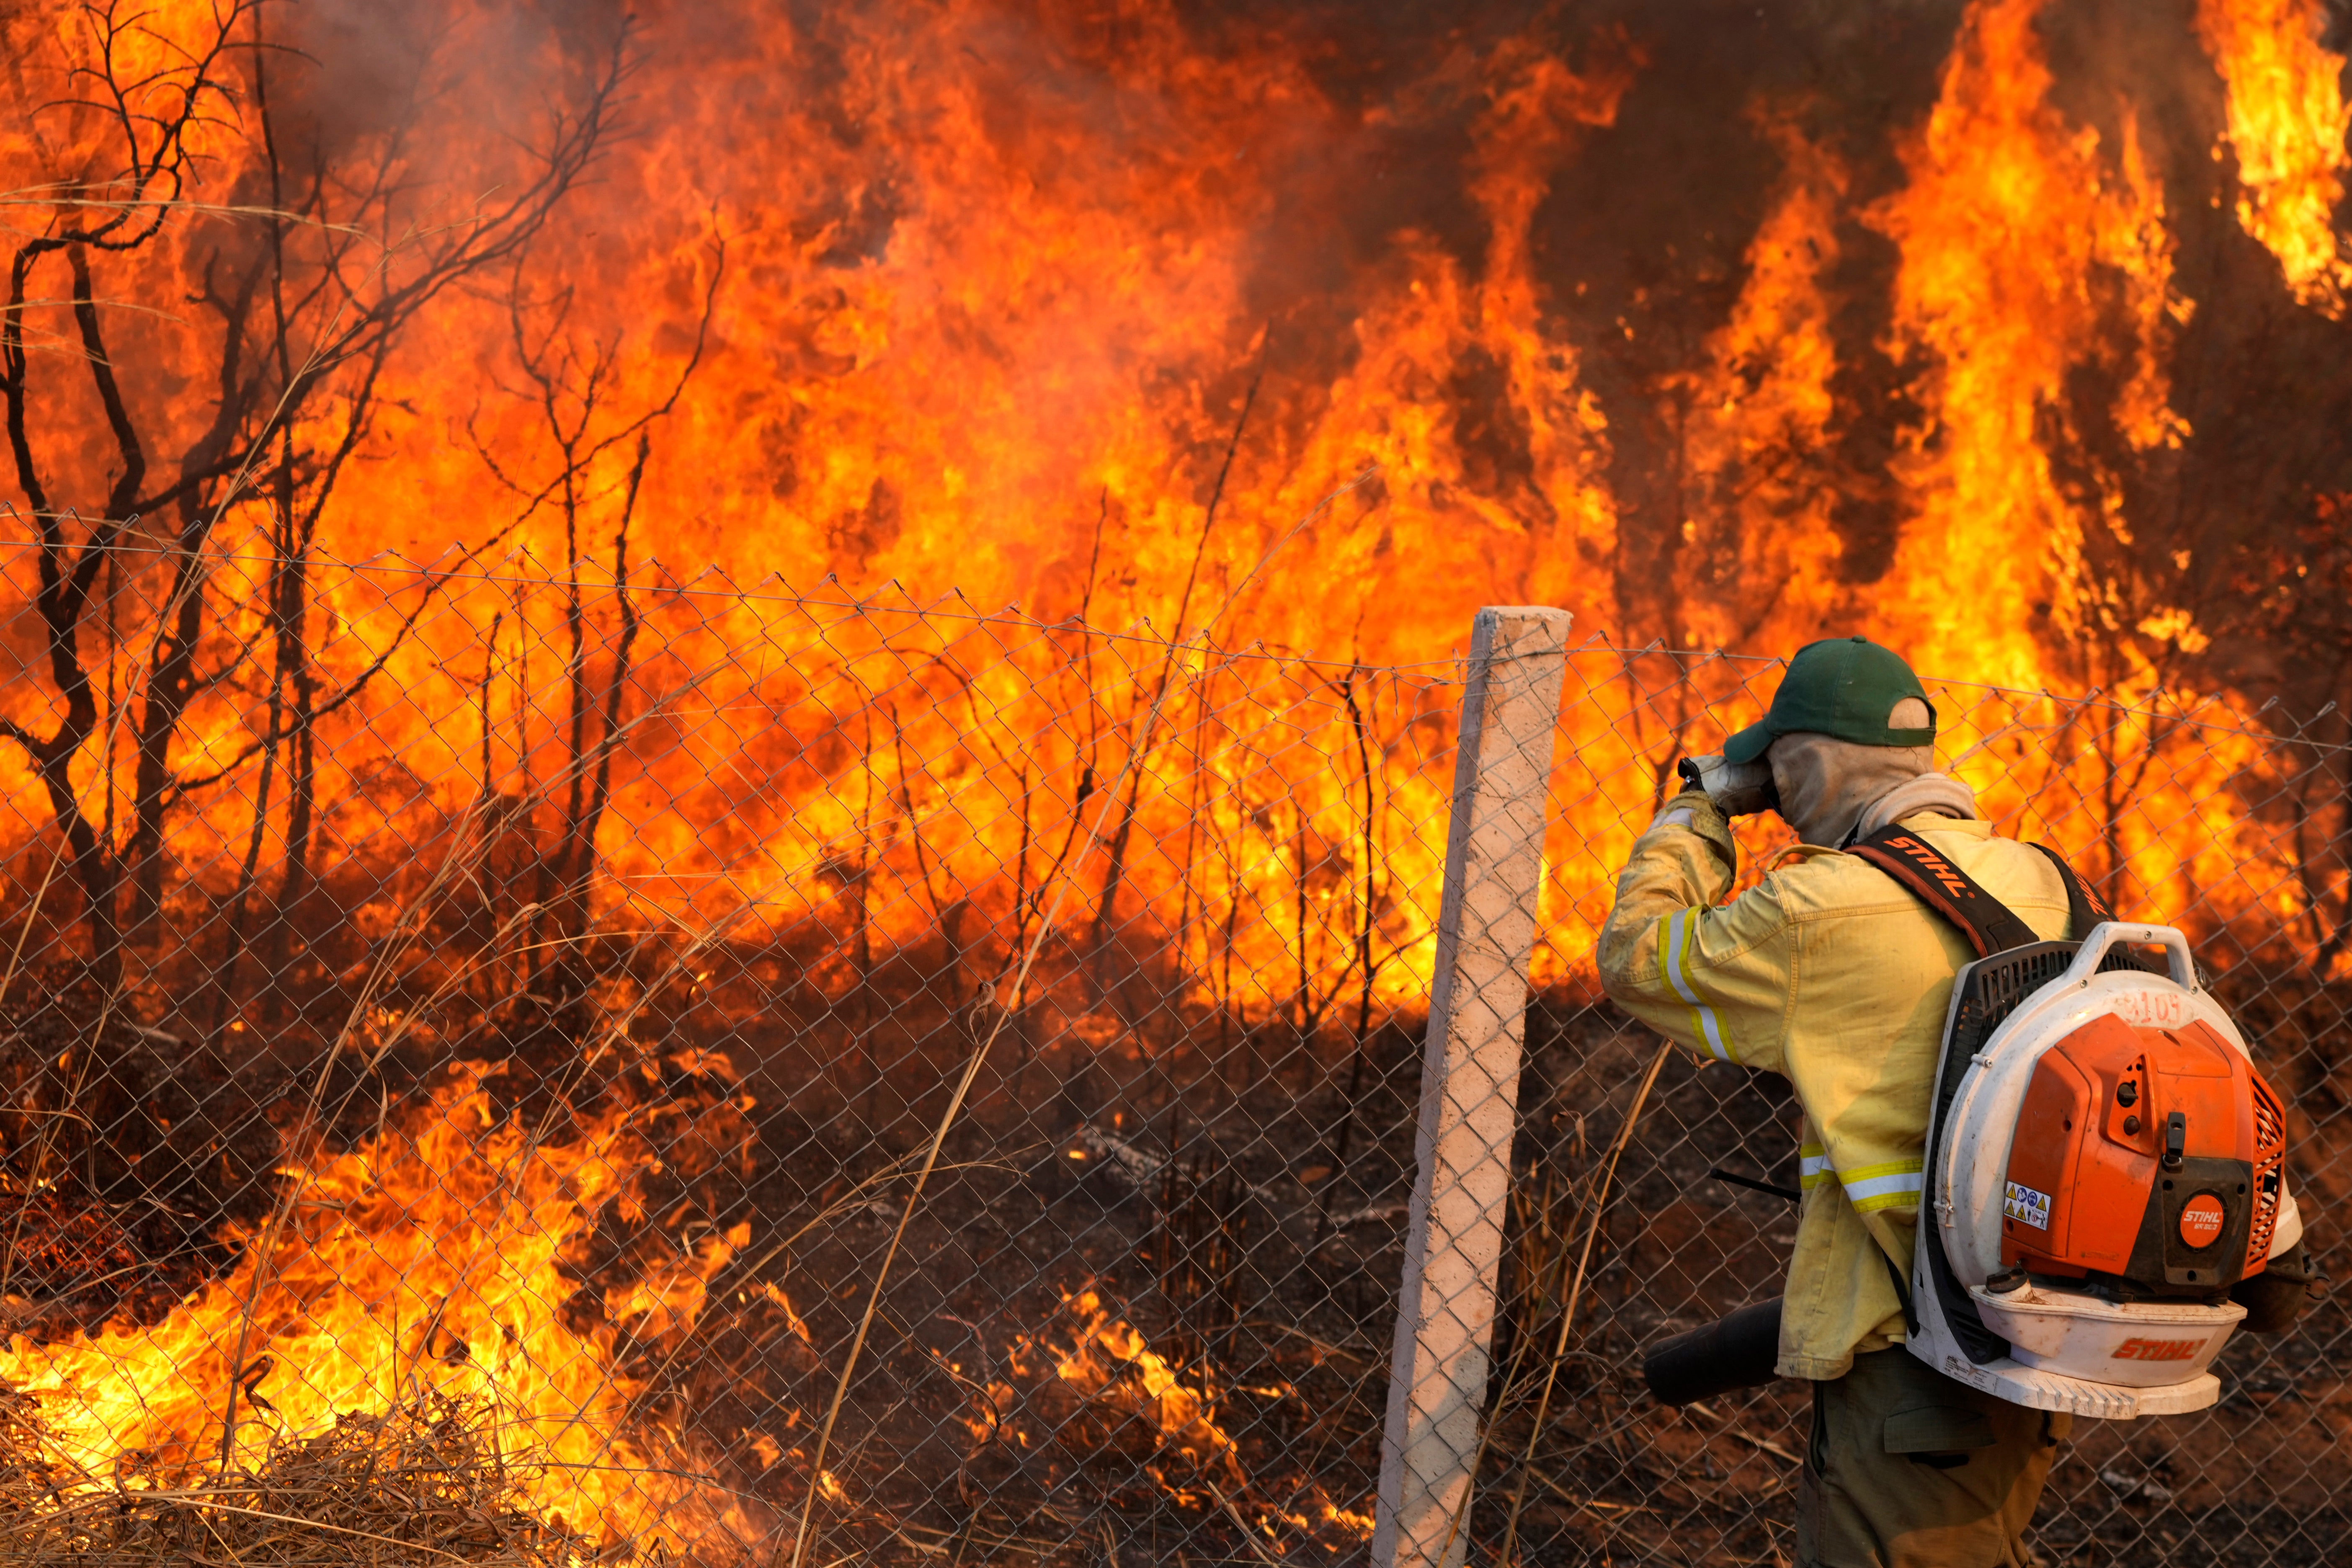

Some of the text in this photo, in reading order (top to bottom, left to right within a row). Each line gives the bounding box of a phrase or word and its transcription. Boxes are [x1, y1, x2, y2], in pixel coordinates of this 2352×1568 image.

[1883, 836, 1967, 897] STIHL
[2183, 1210, 2220, 1223] STIHL
[2115, 1339, 2195, 1360] STIHL
